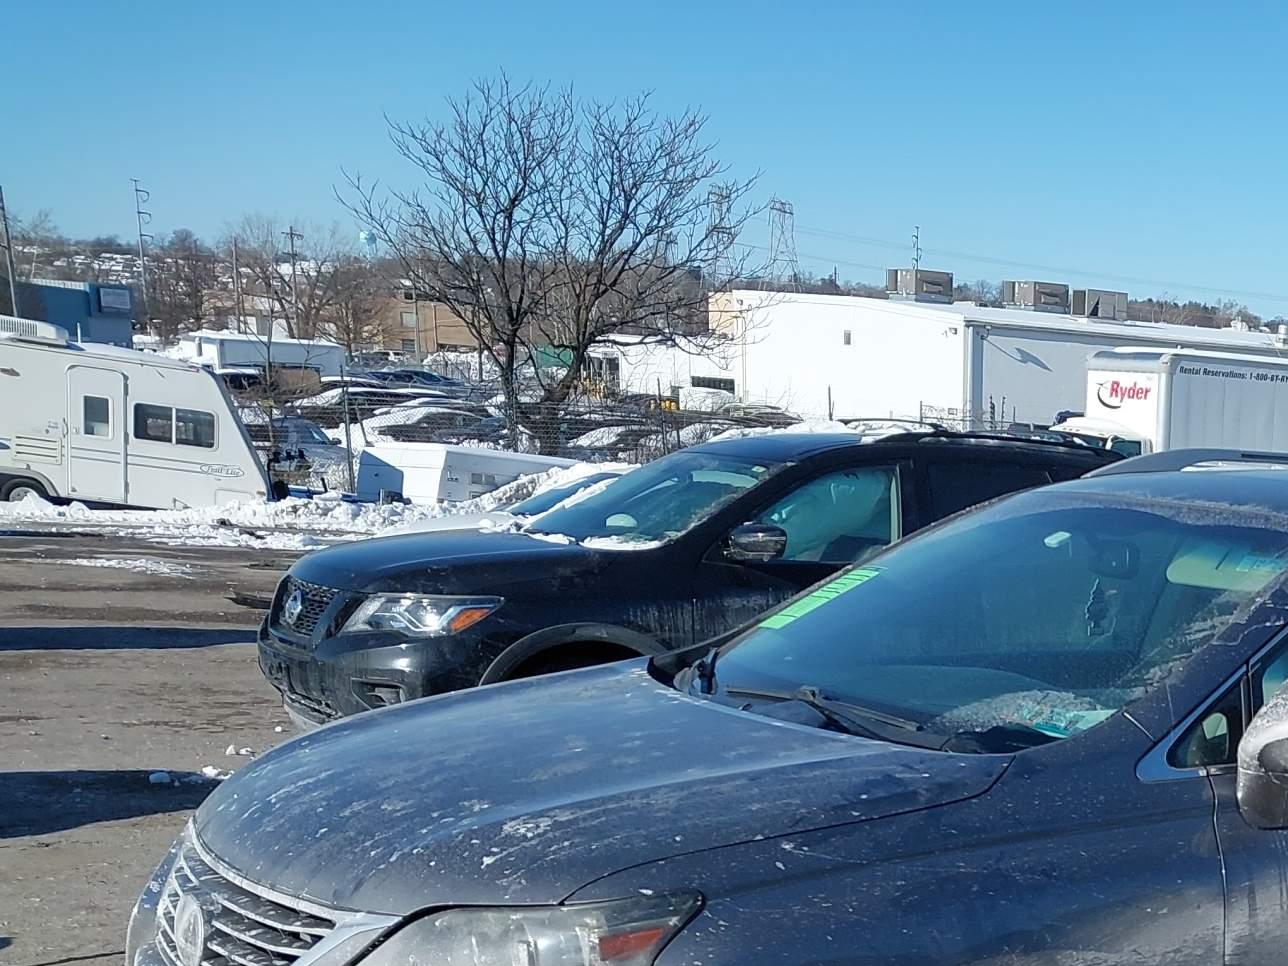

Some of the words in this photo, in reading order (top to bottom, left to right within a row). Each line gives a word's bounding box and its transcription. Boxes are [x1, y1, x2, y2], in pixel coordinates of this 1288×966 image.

[1179, 365, 1201, 376] Rental
[1203, 367, 1248, 380] Reservations:
[1109, 380, 1151, 403] Ryder
